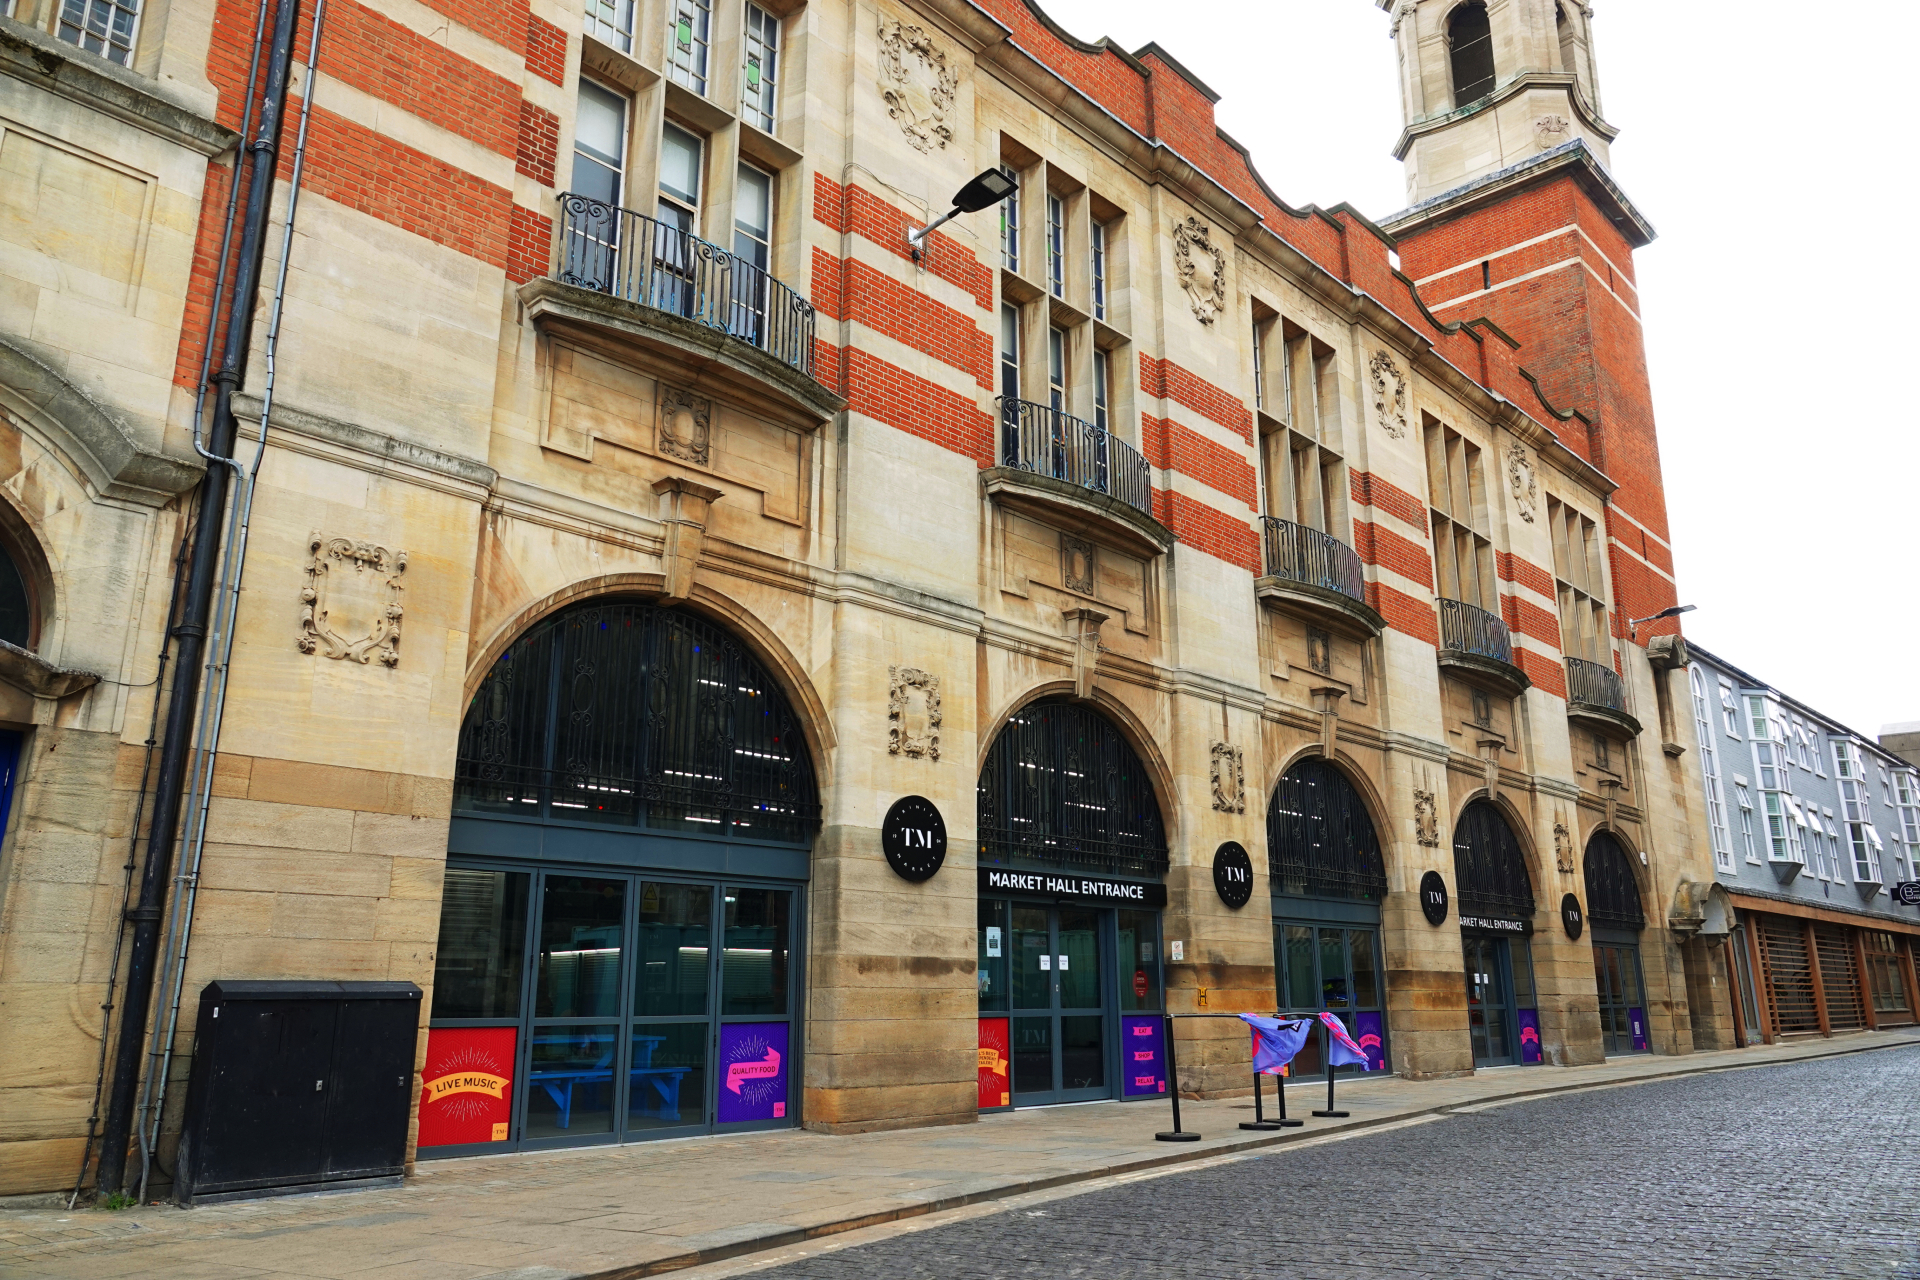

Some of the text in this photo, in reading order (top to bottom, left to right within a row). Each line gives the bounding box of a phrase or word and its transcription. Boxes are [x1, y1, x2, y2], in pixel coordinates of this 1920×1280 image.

[901, 827, 932, 849] TM
[1224, 866, 1245, 883] TM
[989, 871, 1144, 899] MARKET HALL ENTRANCE
[1428, 890, 1442, 905] TM
[1478, 917, 1494, 929] HALL
[1494, 919, 1523, 931] ENTRANCE
[1567, 910, 1580, 923] TM
[1022, 1029, 1046, 1044] TM
[732, 1067, 758, 1075] QUALITY
[436, 1077, 498, 1093] LIVE MUSIC
